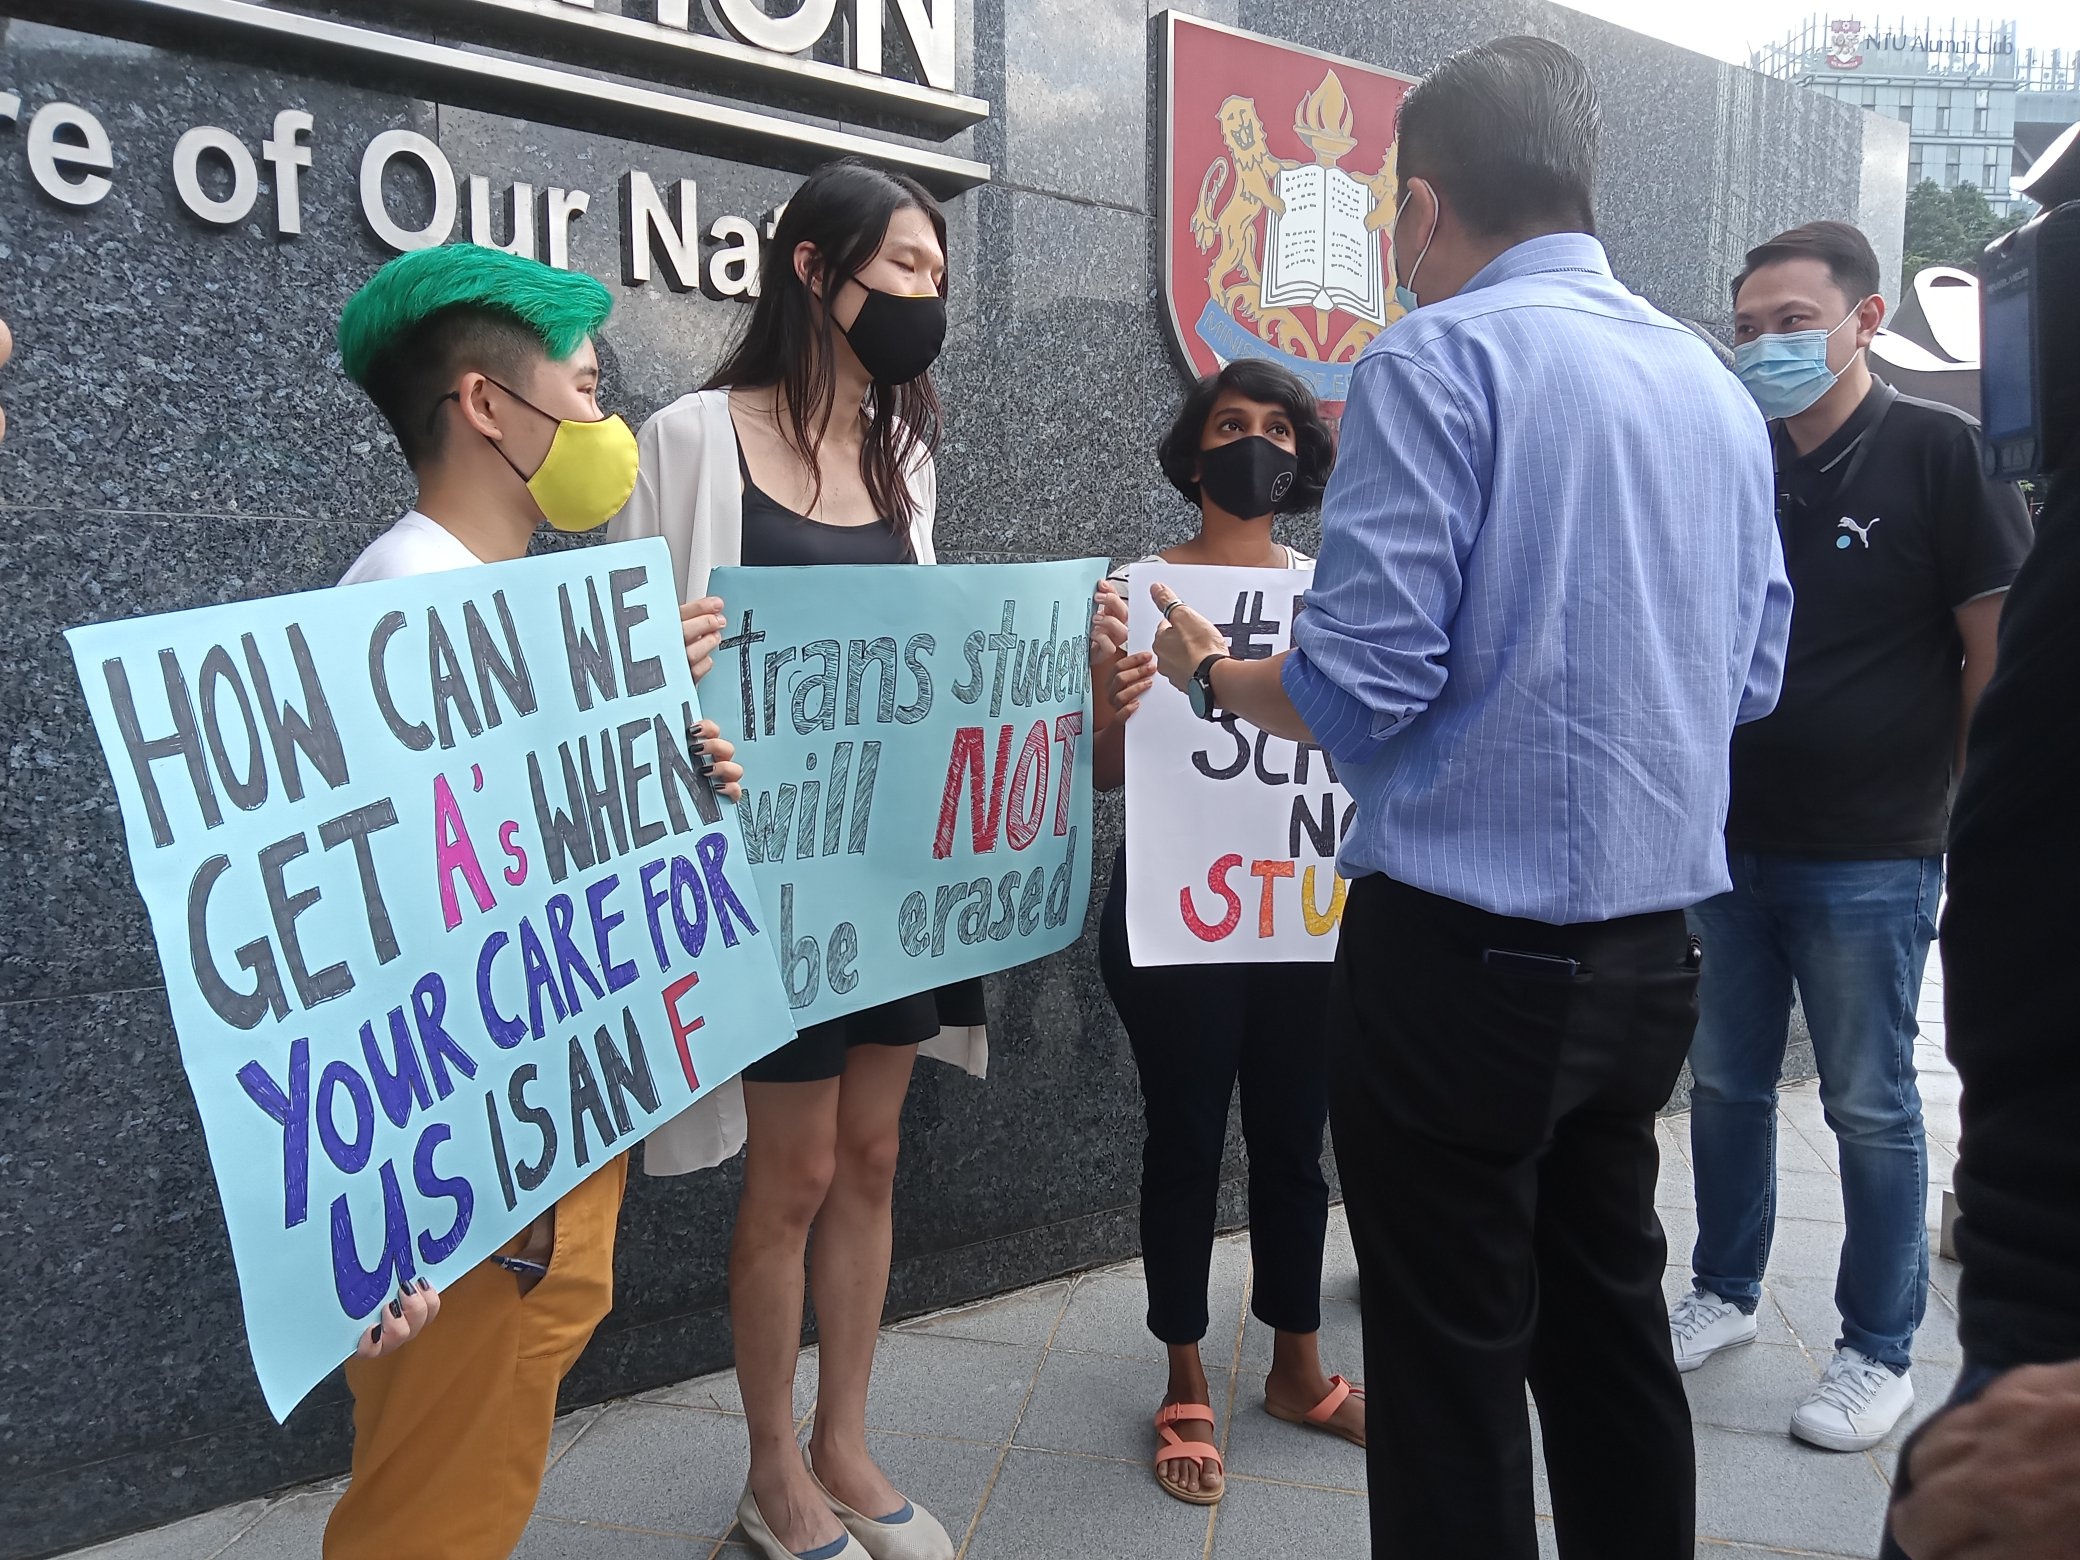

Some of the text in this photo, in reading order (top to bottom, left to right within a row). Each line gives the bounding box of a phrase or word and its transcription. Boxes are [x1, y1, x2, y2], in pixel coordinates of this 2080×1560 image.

[1866, 32, 2013, 56] NTU Alumni Club
[0, 92, 789, 297] e of Our Na
[103, 566, 666, 848] HOW CAN WE
[719, 597, 1091, 742] trans student
[187, 701, 722, 1030] GET A's WHEN
[737, 711, 1083, 864] will NOT
[1289, 792, 1358, 858] N
[781, 826, 1077, 1009] be erased
[1180, 853, 1348, 943] STU
[235, 832, 760, 1229] YOUR CARE FOR
[329, 972, 706, 1320] US IS AN F
